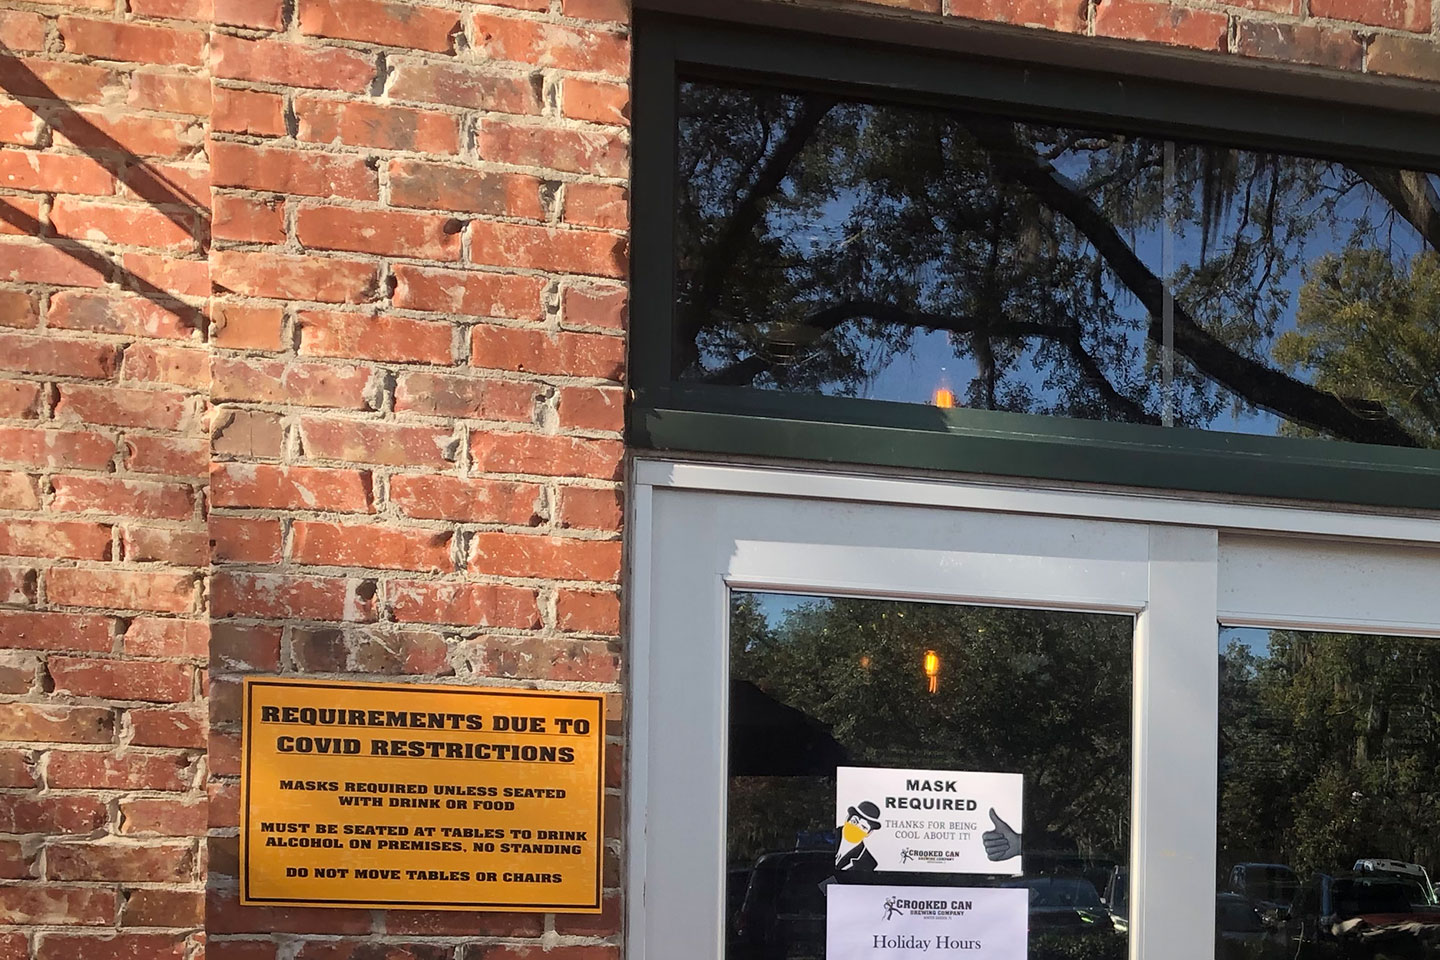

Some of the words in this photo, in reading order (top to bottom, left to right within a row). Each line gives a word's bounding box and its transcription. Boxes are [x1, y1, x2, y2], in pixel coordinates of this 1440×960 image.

[261, 706, 482, 731] REQUIREMENTS
[492, 716, 546, 732] DUE
[554, 718, 591, 735] TO
[276, 736, 361, 755] COVID
[371, 740, 576, 762] RESTRICTIONS
[279, 779, 339, 792] MASKS
[344, 782, 428, 795] REQUIRED
[433, 785, 498, 797] UNLESS
[503, 788, 566, 799] SEATED
[906, 780, 957, 792] MASK
[338, 796, 384, 808] WITH
[389, 798, 441, 809] DRINK
[445, 799, 468, 810] OR
[472, 800, 515, 811] FOOD
[885, 797, 977, 811] REQUIRED
[261, 822, 310, 834] MUST
[316, 823, 338, 834] BE
[343, 824, 409, 837] SEATED
[414, 826, 436, 837] AT
[441, 827, 505, 839] TABLES
[509, 829, 532, 840] TO
[537, 830, 588, 841] DRINK
[885, 820, 924, 829] THANKS
[928, 821, 945, 829] FOR
[949, 822, 977, 830] BEING
[895, 831, 920, 839] COOL
[923, 832, 956, 840] ABOUT
[265, 837, 344, 849] ALCOHOL
[349, 839, 372, 850] ON
[378, 840, 467, 852] PREMISES,
[472, 842, 496, 852] NO
[500, 843, 582, 855] STANDING
[909, 850, 943, 858] CROOKED
[286, 867, 309, 878] DO
[314, 868, 349, 879] NOT
[354, 869, 401, 880] MOVE
[406, 870, 471, 882] TABLES
[475, 872, 498, 882] OR
[502, 873, 562, 883] CHAIRS
[896, 899, 948, 910] CROOKED
[951, 901, 972, 910] CAN
[873, 935, 931, 952] Holiday
[936, 936, 981, 949] Hours
